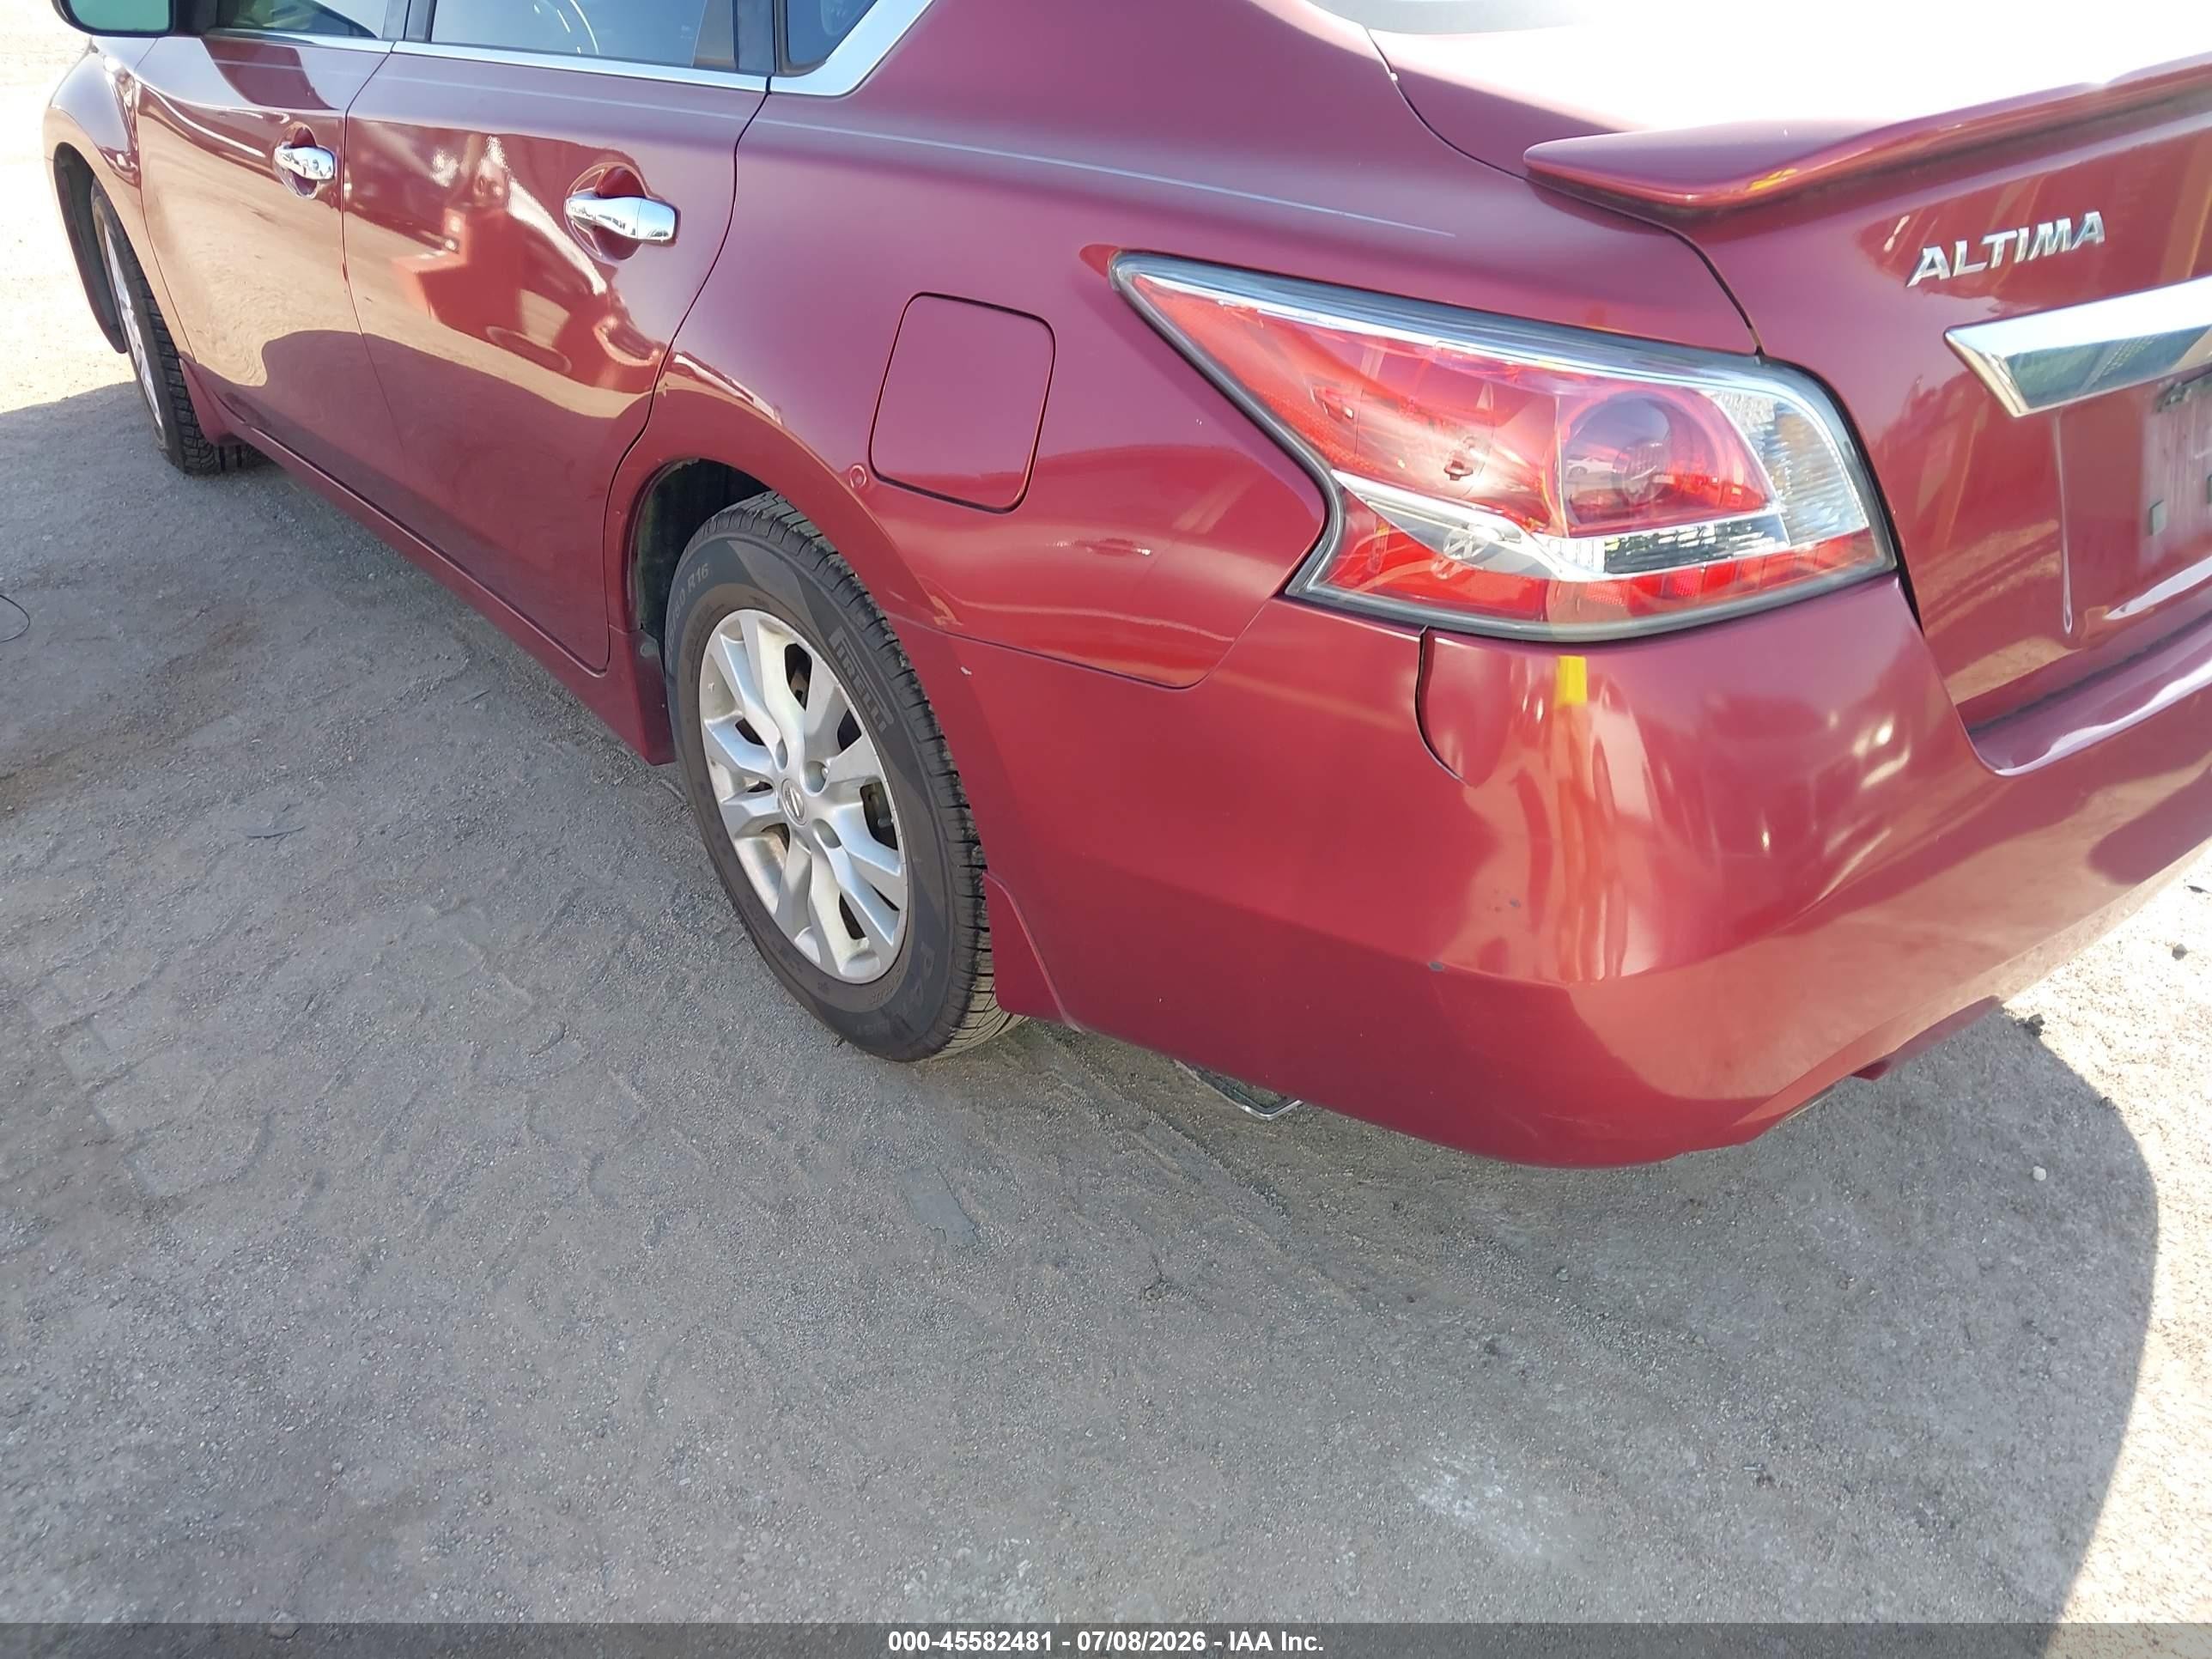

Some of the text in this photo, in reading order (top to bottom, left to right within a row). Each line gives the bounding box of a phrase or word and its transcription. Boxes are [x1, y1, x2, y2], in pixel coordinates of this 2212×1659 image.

[1905, 210, 2105, 288] ALTIMA
[687, 562, 708, 592] R16
[828, 626, 894, 732] PIRELLI
